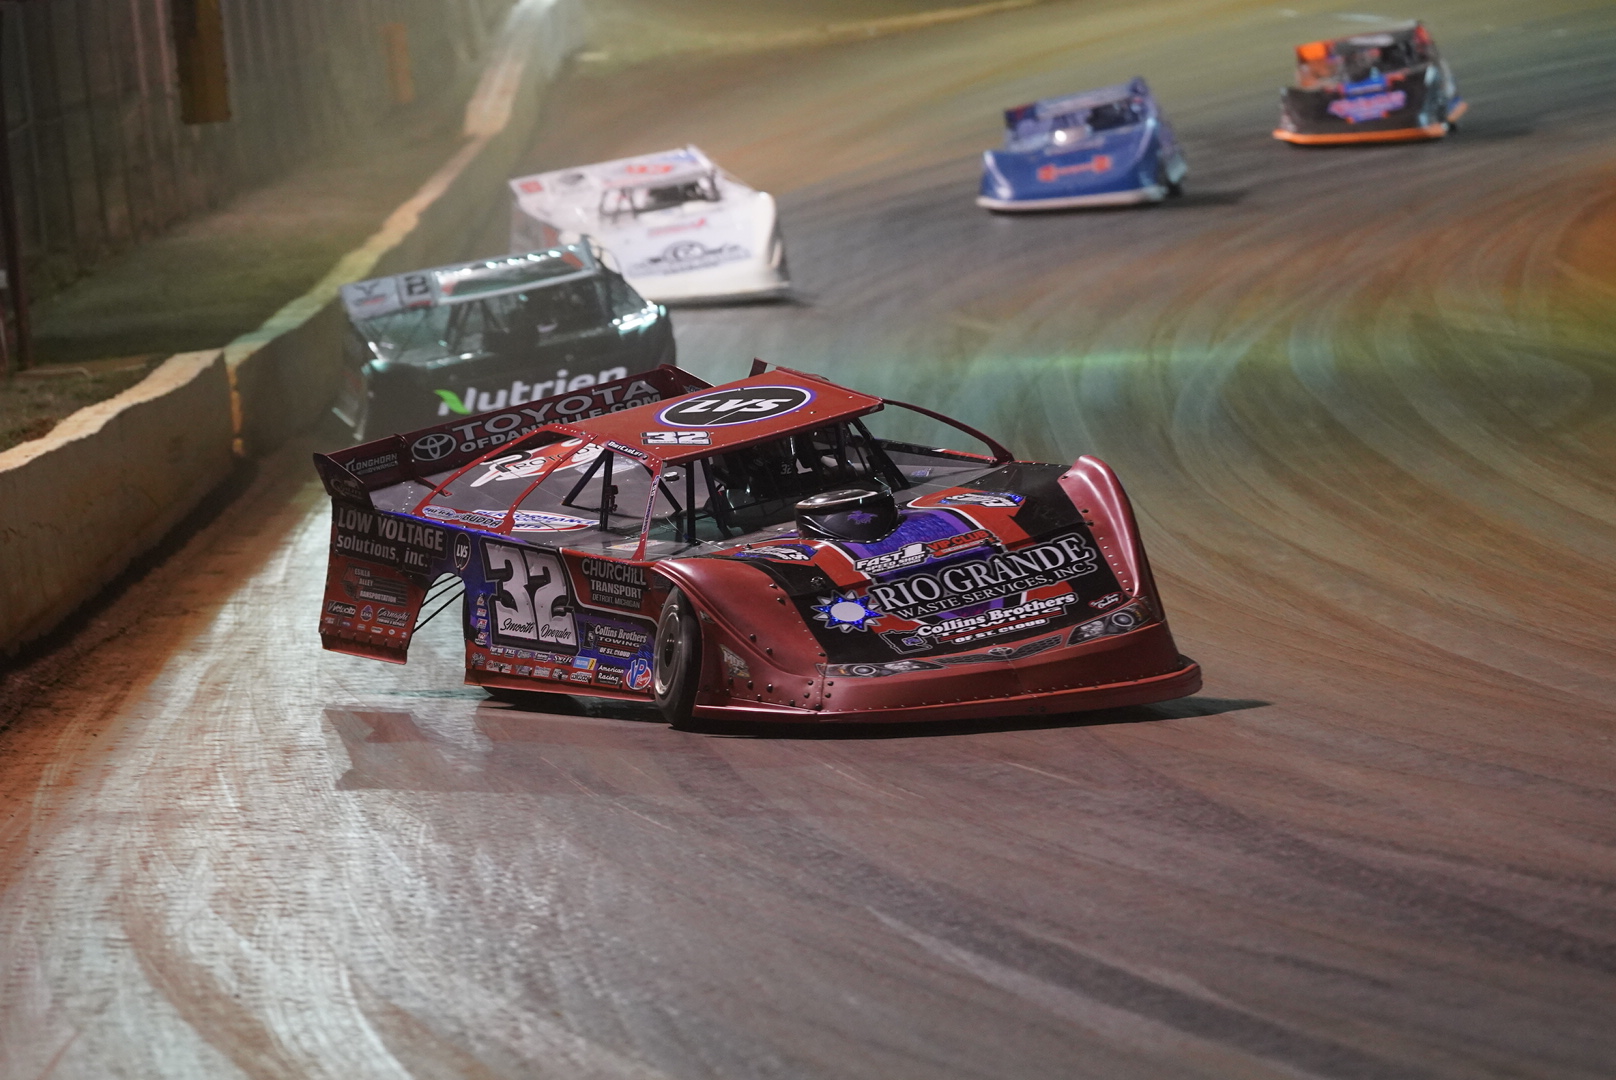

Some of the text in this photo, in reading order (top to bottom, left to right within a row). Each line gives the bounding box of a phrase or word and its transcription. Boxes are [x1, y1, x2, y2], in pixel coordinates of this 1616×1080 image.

[434, 366, 627, 416] Nutrien
[452, 380, 659, 441] TOYOTA
[642, 431, 711, 445] 32
[350, 453, 398, 471] LONGHORN
[338, 507, 444, 551] LOW VOLTAGE
[928, 540, 951, 550] VIP
[951, 530, 989, 545] CLUB
[336, 534, 428, 568] solutions, inc.
[456, 544, 469, 558] LVS
[856, 552, 903, 569] FAST
[581, 557, 647, 586] CHURCHILL
[865, 561, 896, 572] SPEED
[898, 554, 925, 563] SHOP
[872, 536, 1090, 611] RIO GRANDE
[485, 542, 577, 646] 32
[590, 579, 642, 599] TRANSPORT
[897, 562, 1092, 620] WASTE SERVICES, INC.
[592, 593, 641, 609] DETROIT, MICHIGAN
[918, 615, 986, 636] Collins
[989, 593, 1075, 620] Brothers
[500, 617, 572, 643] Smooth Operator
[595, 624, 648, 643] Collins Brothers
[954, 634, 971, 643] OF
[999, 618, 1047, 633] CLOUD
[599, 636, 640, 648] TOWING
[598, 665, 624, 674] American
[598, 672, 619, 684] Racing
